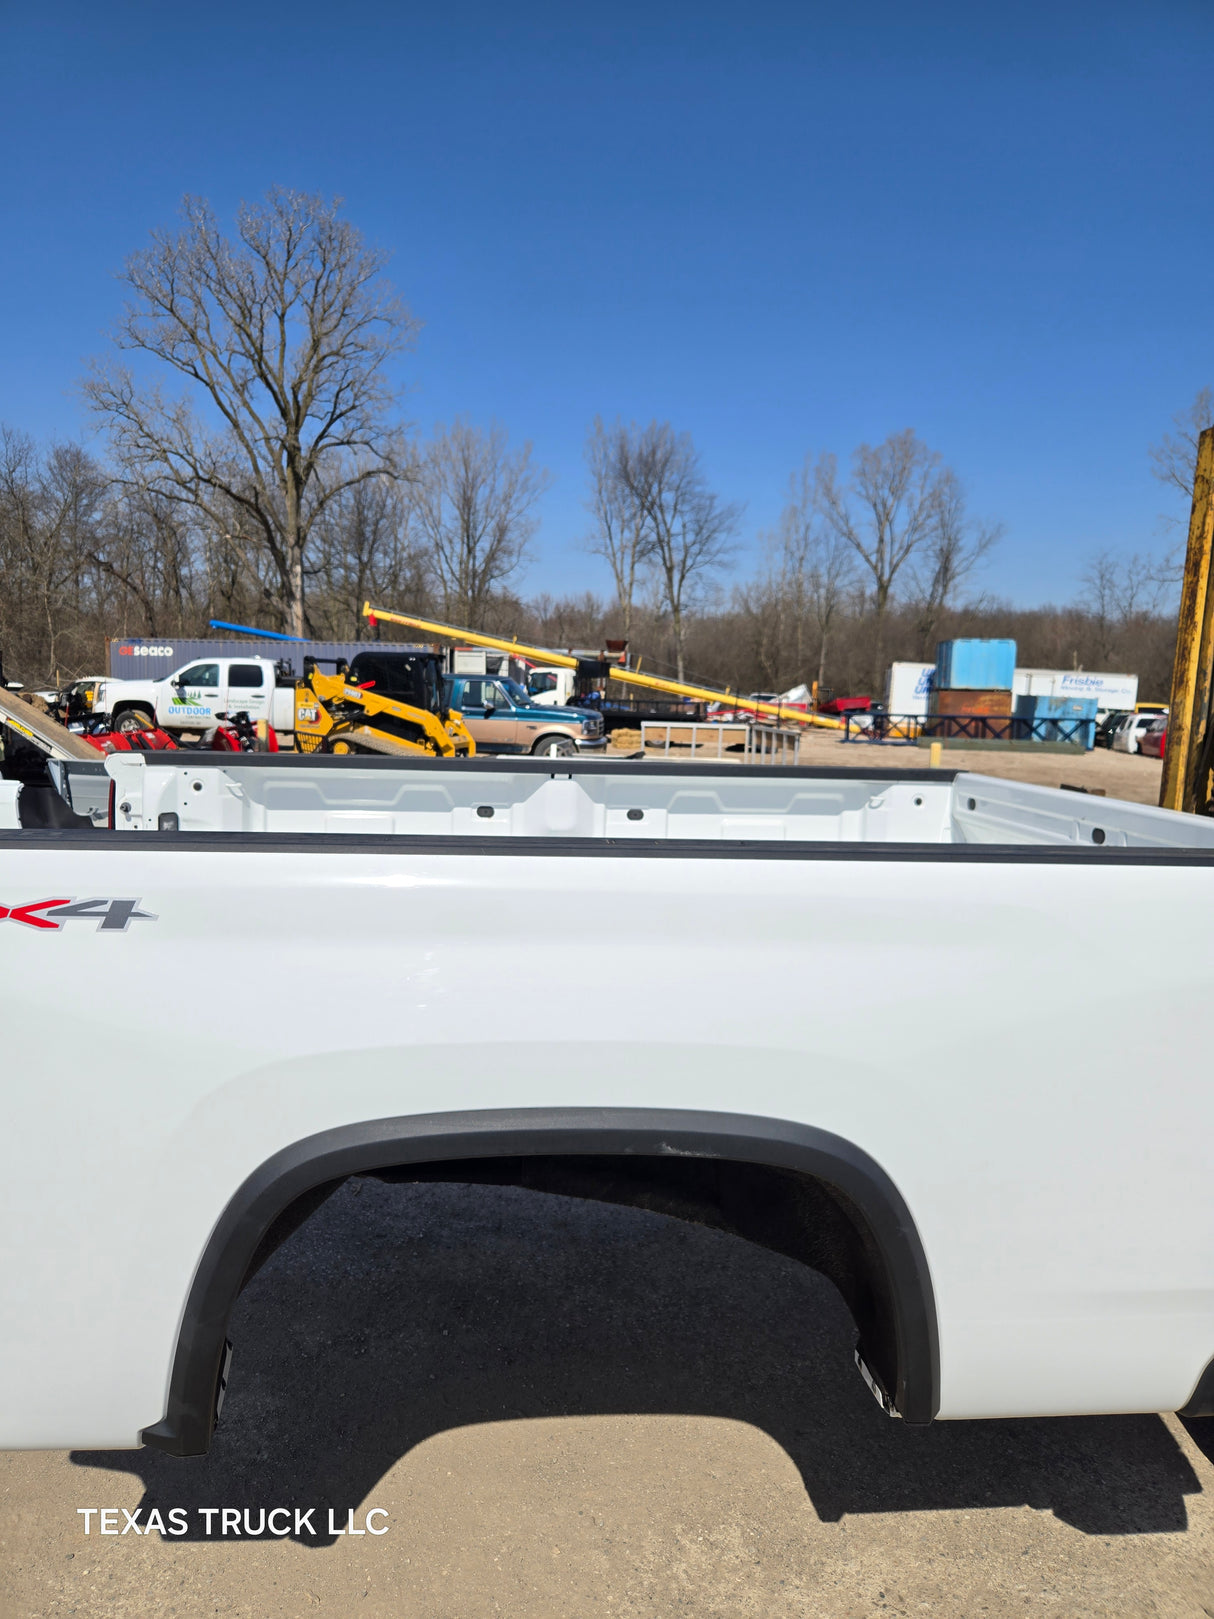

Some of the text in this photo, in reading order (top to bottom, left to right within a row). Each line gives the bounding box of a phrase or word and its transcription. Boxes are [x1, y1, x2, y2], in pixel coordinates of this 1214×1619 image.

[1062, 675, 1104, 687] Frisbie
[168, 706, 212, 715] OUTDOOR
[298, 708, 317, 721] CAT
